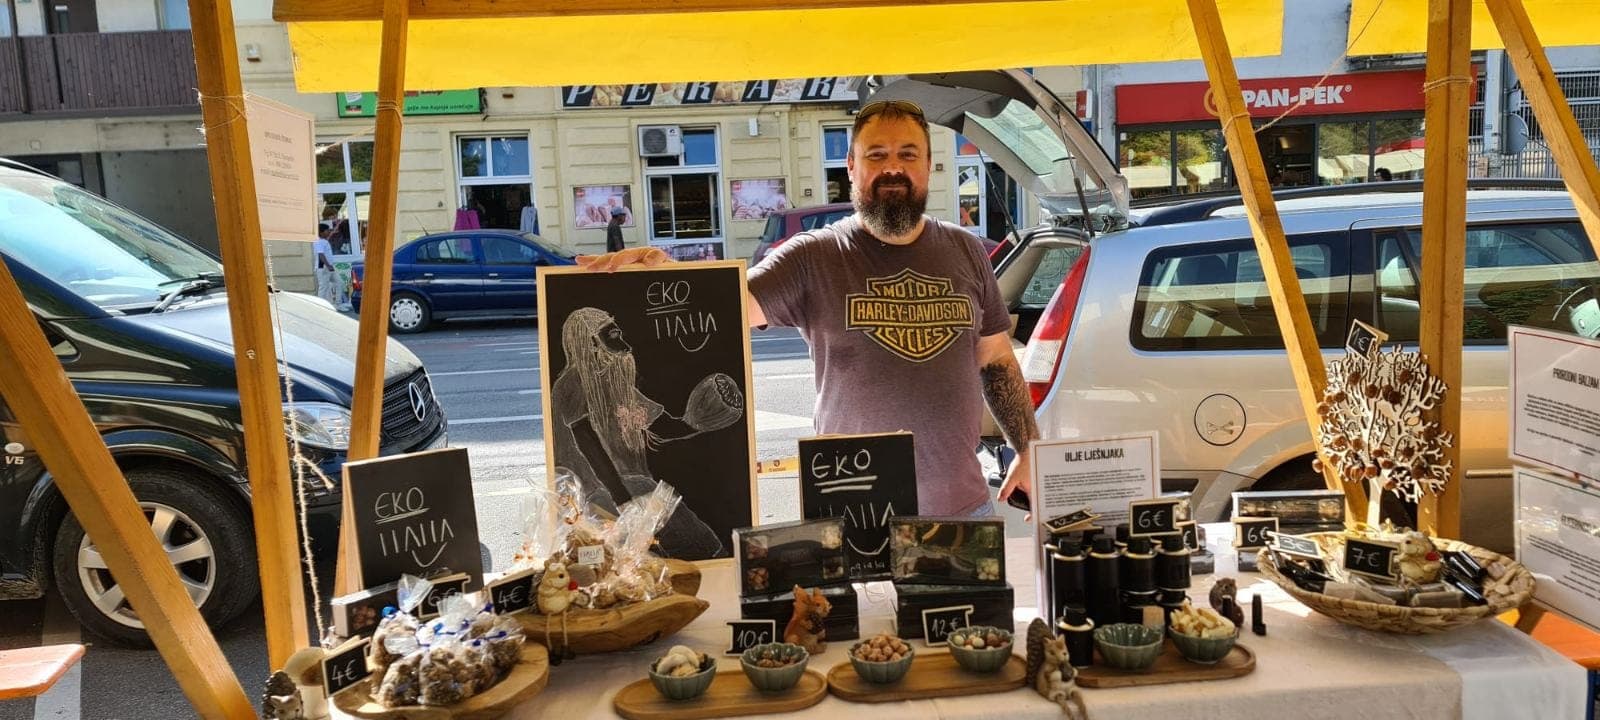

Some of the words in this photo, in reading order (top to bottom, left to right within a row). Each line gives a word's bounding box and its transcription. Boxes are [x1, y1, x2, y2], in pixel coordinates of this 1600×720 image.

[1241, 85, 1345, 107] PAN-PEK
[646, 280, 690, 305] EKO
[883, 279, 940, 298] MOTOR
[857, 302, 967, 322] HARLEY-DAVIDSON
[885, 327, 944, 353] CYCLES
[5, 455, 24, 465] V6
[811, 449, 871, 478] EKO
[1065, 451, 1083, 462] ULJE
[1084, 447, 1125, 461] LJEŠNJAKA
[375, 486, 424, 519] EKO
[1138, 510, 1166, 529] 6€
[1351, 547, 1380, 567] 7€
[498, 585, 525, 608] 4€
[331, 658, 357, 687] 4€
